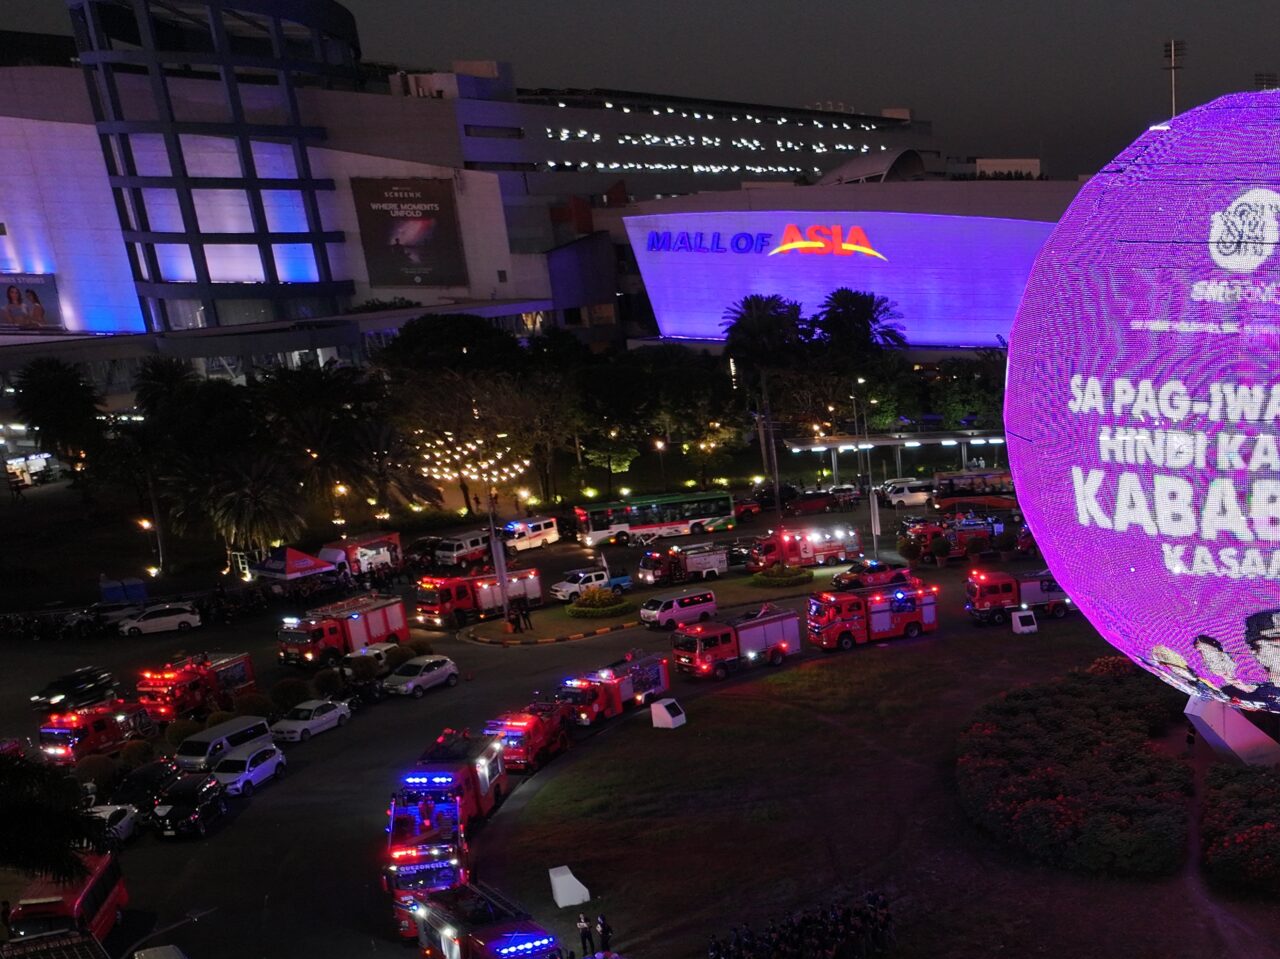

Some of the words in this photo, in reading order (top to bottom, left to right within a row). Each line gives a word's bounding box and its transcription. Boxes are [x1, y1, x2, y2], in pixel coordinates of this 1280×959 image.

[370, 202, 399, 211] WHERE
[400, 203, 440, 211] MOMENTS
[647, 230, 728, 254] MALL
[730, 232, 773, 254] OF
[776, 223, 880, 258] ASIA
[1068, 373, 1104, 414] SA
[1099, 427, 1203, 469] HINDI
